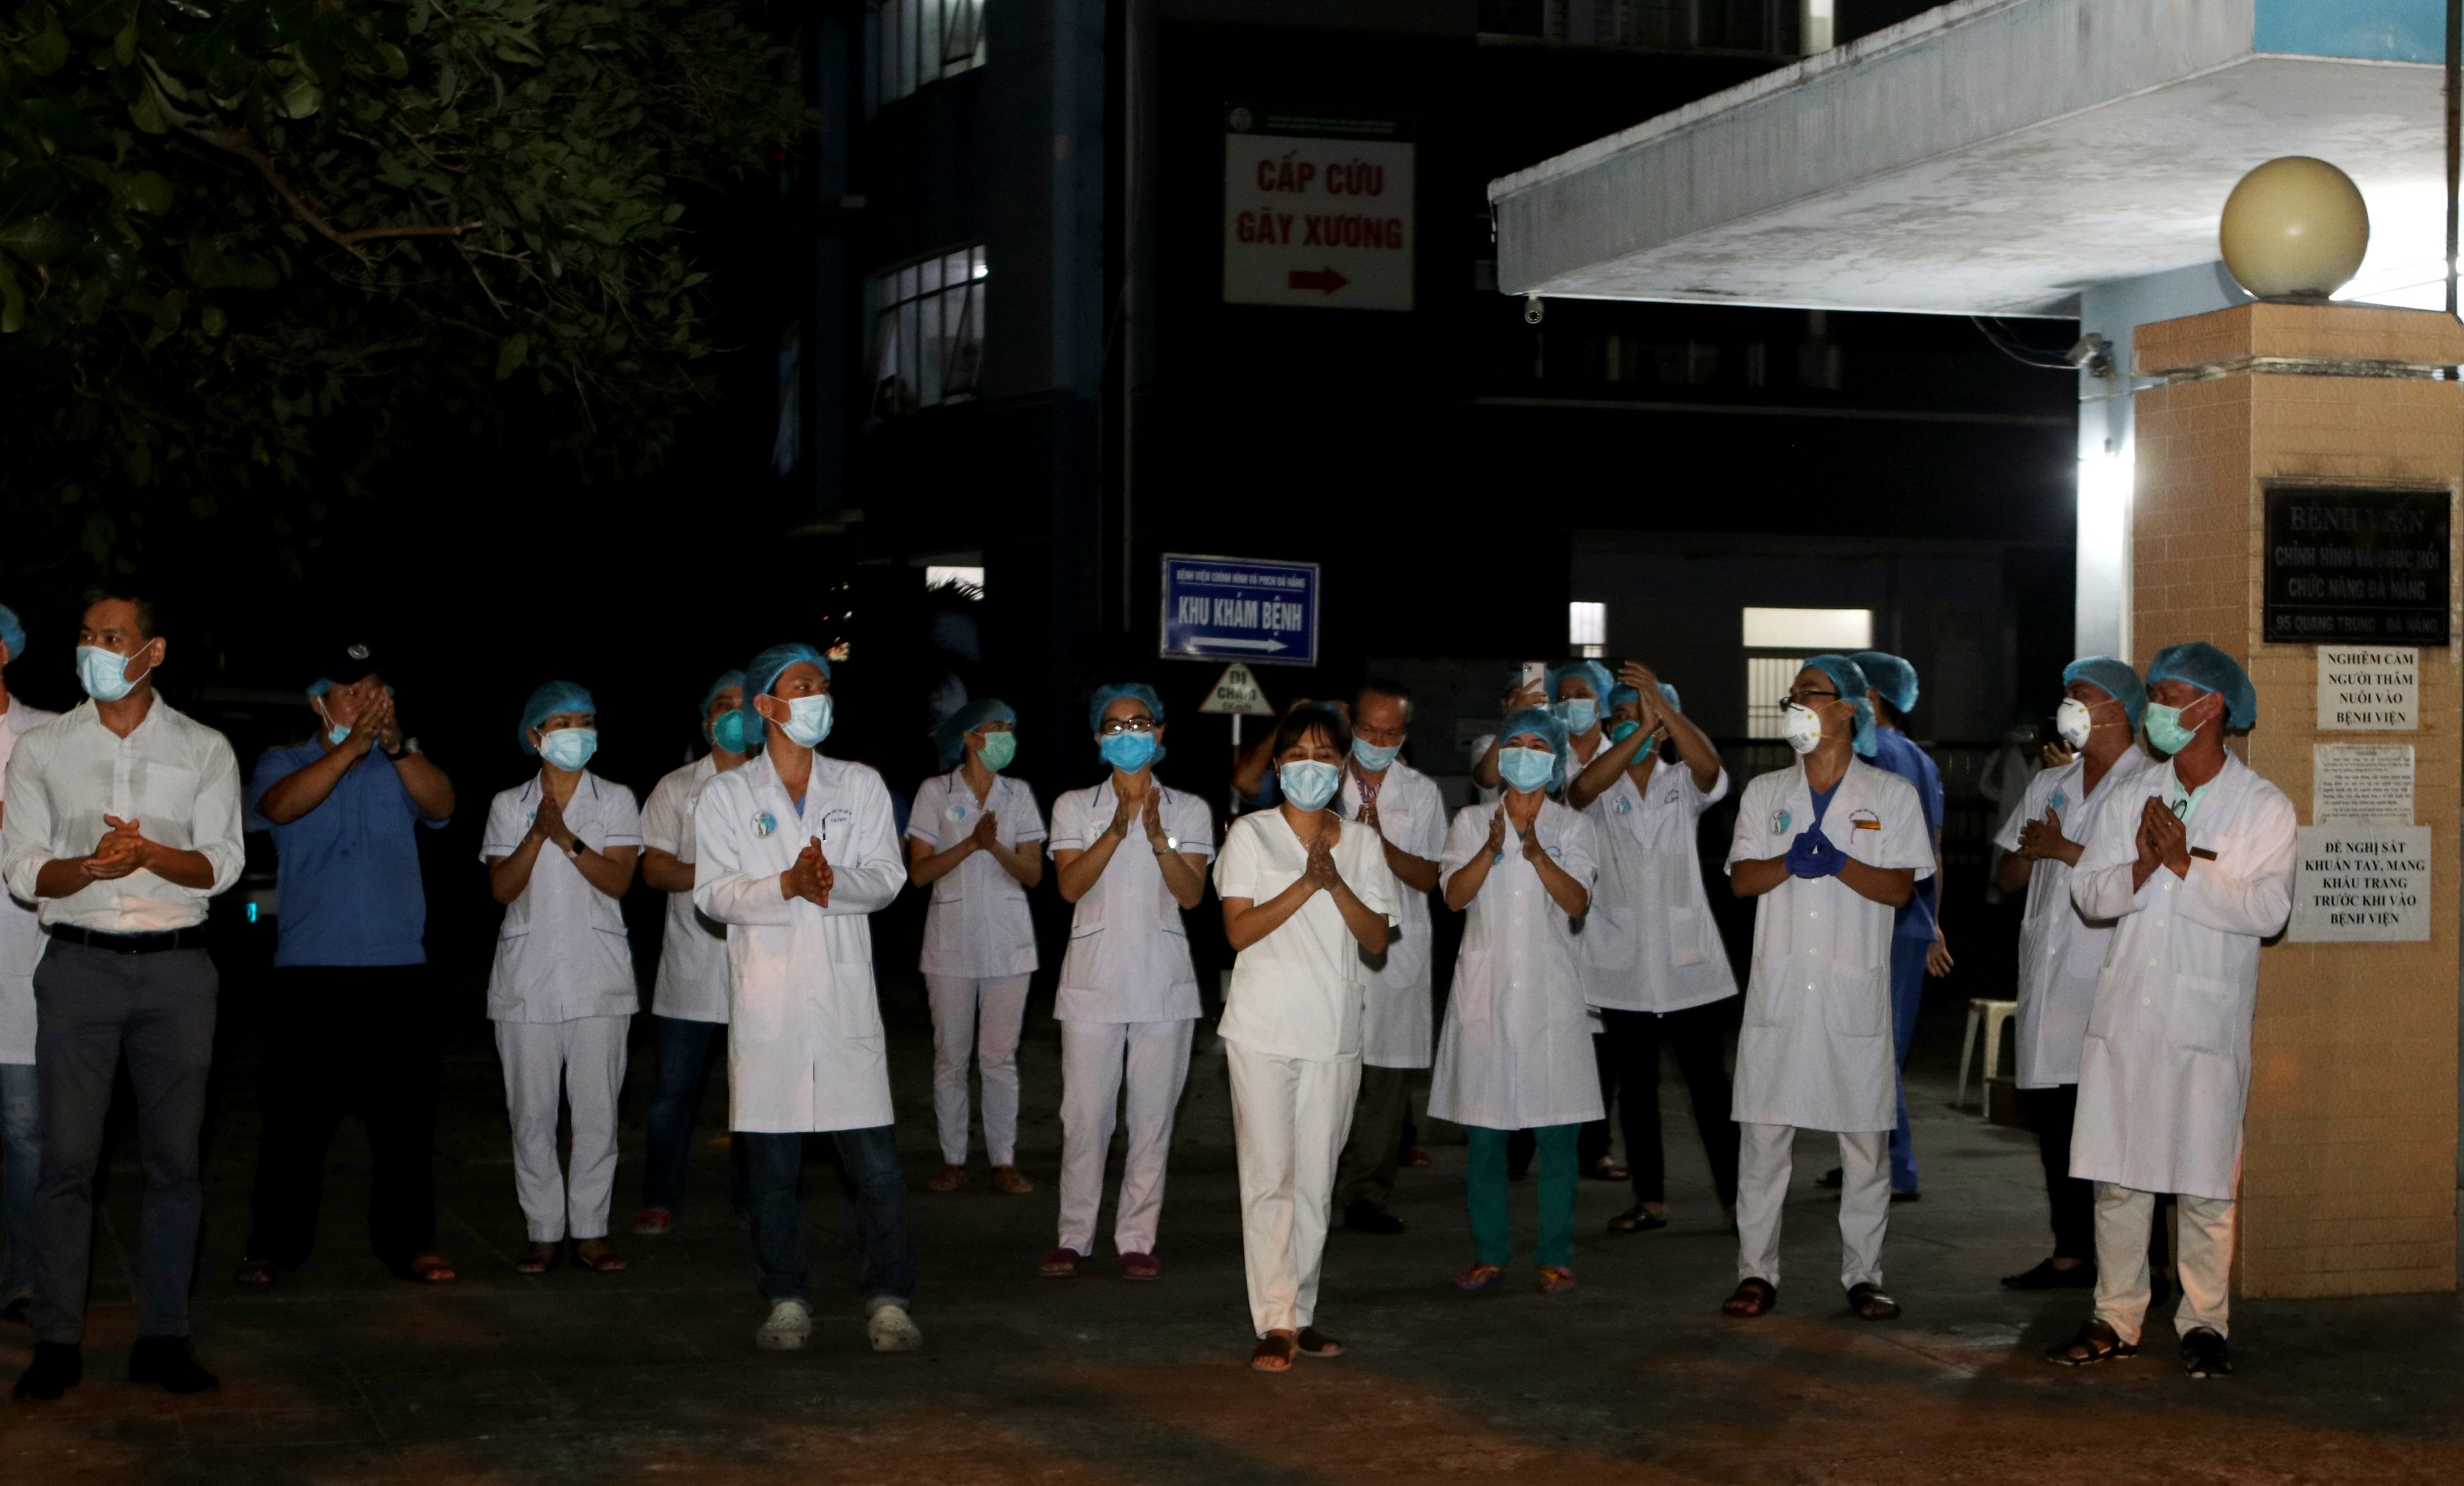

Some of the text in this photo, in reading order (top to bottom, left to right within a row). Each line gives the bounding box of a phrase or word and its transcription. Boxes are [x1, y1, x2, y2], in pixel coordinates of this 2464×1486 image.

[1258, 151, 1384, 196] CẤP CỨU
[1238, 206, 1403, 249] GÃY XƯƠNG
[2289, 500, 2426, 538] BỆNH VỆN
[2319, 543, 2352, 566] HÌNH
[2288, 575, 2324, 597] CHỨC
[2329, 575, 2365, 599] NĂNG
[1178, 591, 1302, 636] KHU KHÁM BỆNH
[2276, 615, 2291, 631] 95
[2294, 616, 2333, 632] QUANG
[2336, 616, 2376, 632] TRUNG
[2328, 651, 2381, 664] NGHIÊM
[2329, 671, 2413, 684] NGƯỜI THĂM
[2340, 689, 2402, 704] NUÔI VÀO
[2337, 710, 2406, 725] BỆNH VIỆN
[2346, 842, 2378, 855] NGHỊ
[2381, 839, 2406, 853] SÁT
[2354, 860, 2383, 871] TAY,
[2386, 860, 2425, 871] MANG
[2363, 878, 2407, 888] TRANG
[2313, 892, 2416, 906] TRƯỚC KHI VÀO
[2331, 912, 2399, 927] BỆNH VIỆN
